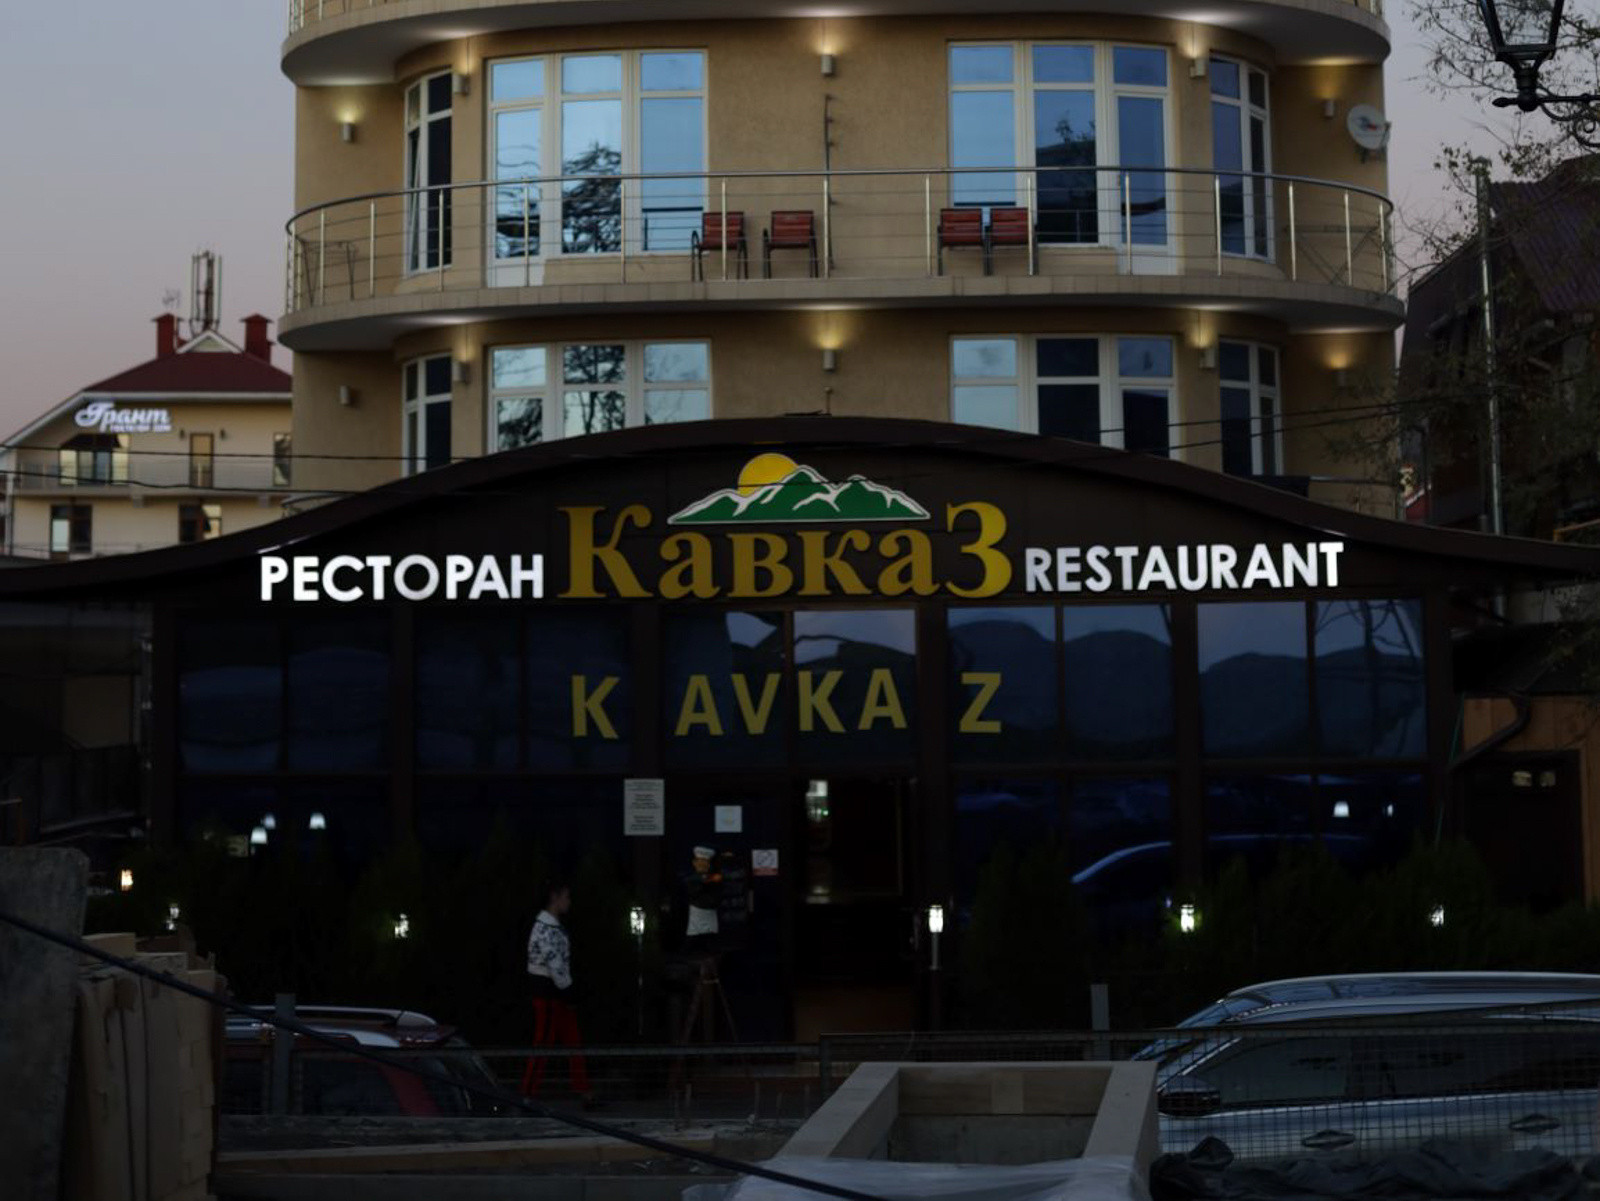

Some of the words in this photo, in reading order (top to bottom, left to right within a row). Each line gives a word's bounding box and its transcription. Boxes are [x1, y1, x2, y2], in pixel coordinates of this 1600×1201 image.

[74, 402, 170, 432] Грант
[259, 553, 544, 601] РЕСТОРАН
[1024, 541, 1345, 594] RESTAURANT
